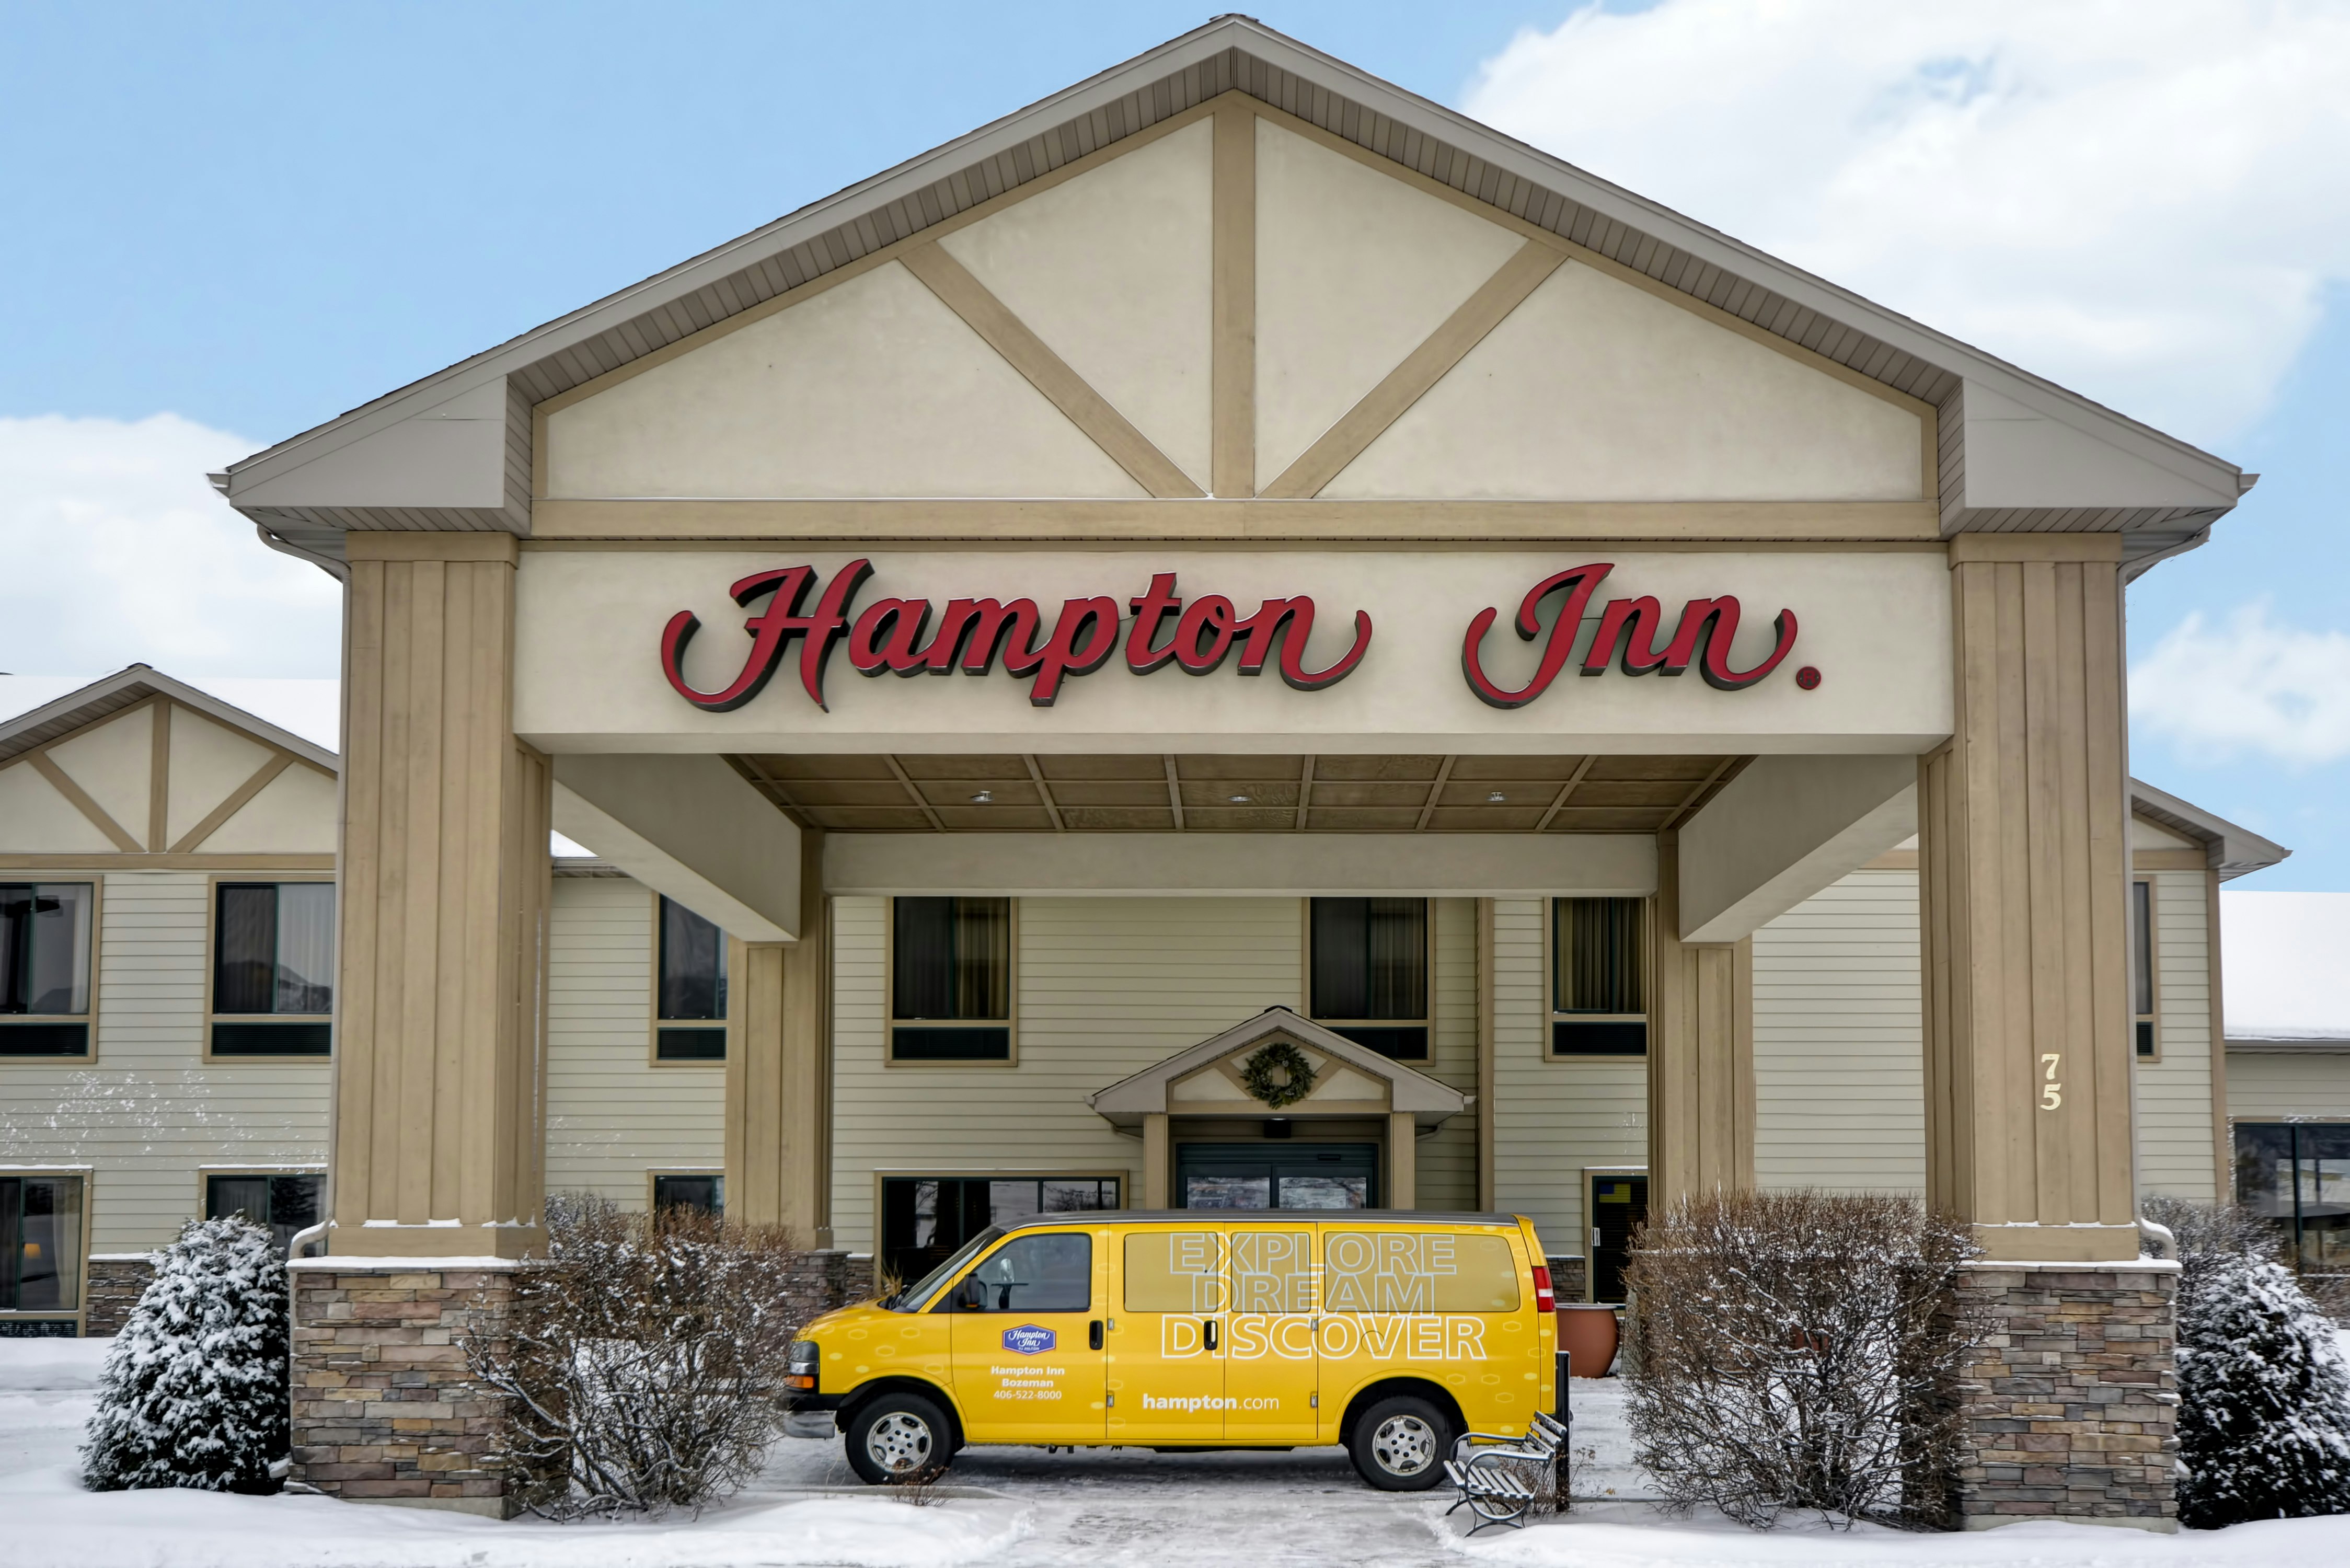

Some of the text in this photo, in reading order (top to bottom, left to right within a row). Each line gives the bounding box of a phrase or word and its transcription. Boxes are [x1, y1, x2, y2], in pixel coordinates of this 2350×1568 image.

[661, 559, 1372, 713] Hampton
[1461, 563, 1798, 709] Inn
[2040, 1054, 2061, 1111] 75
[1170, 1232, 1457, 1275] EXPLORE
[1193, 1272, 1435, 1317] DREAM
[1008, 1329, 1050, 1340] Hampton
[1018, 1338, 1041, 1346] Inn
[1161, 1313, 1488, 1360] DISCOVER
[991, 1366, 1065, 1377] Hampton Inn
[1002, 1378, 1054, 1387] Bozeman
[994, 1390, 1062, 1399] 406-522-8000
[1143, 1393, 1280, 1413] hampton.com
